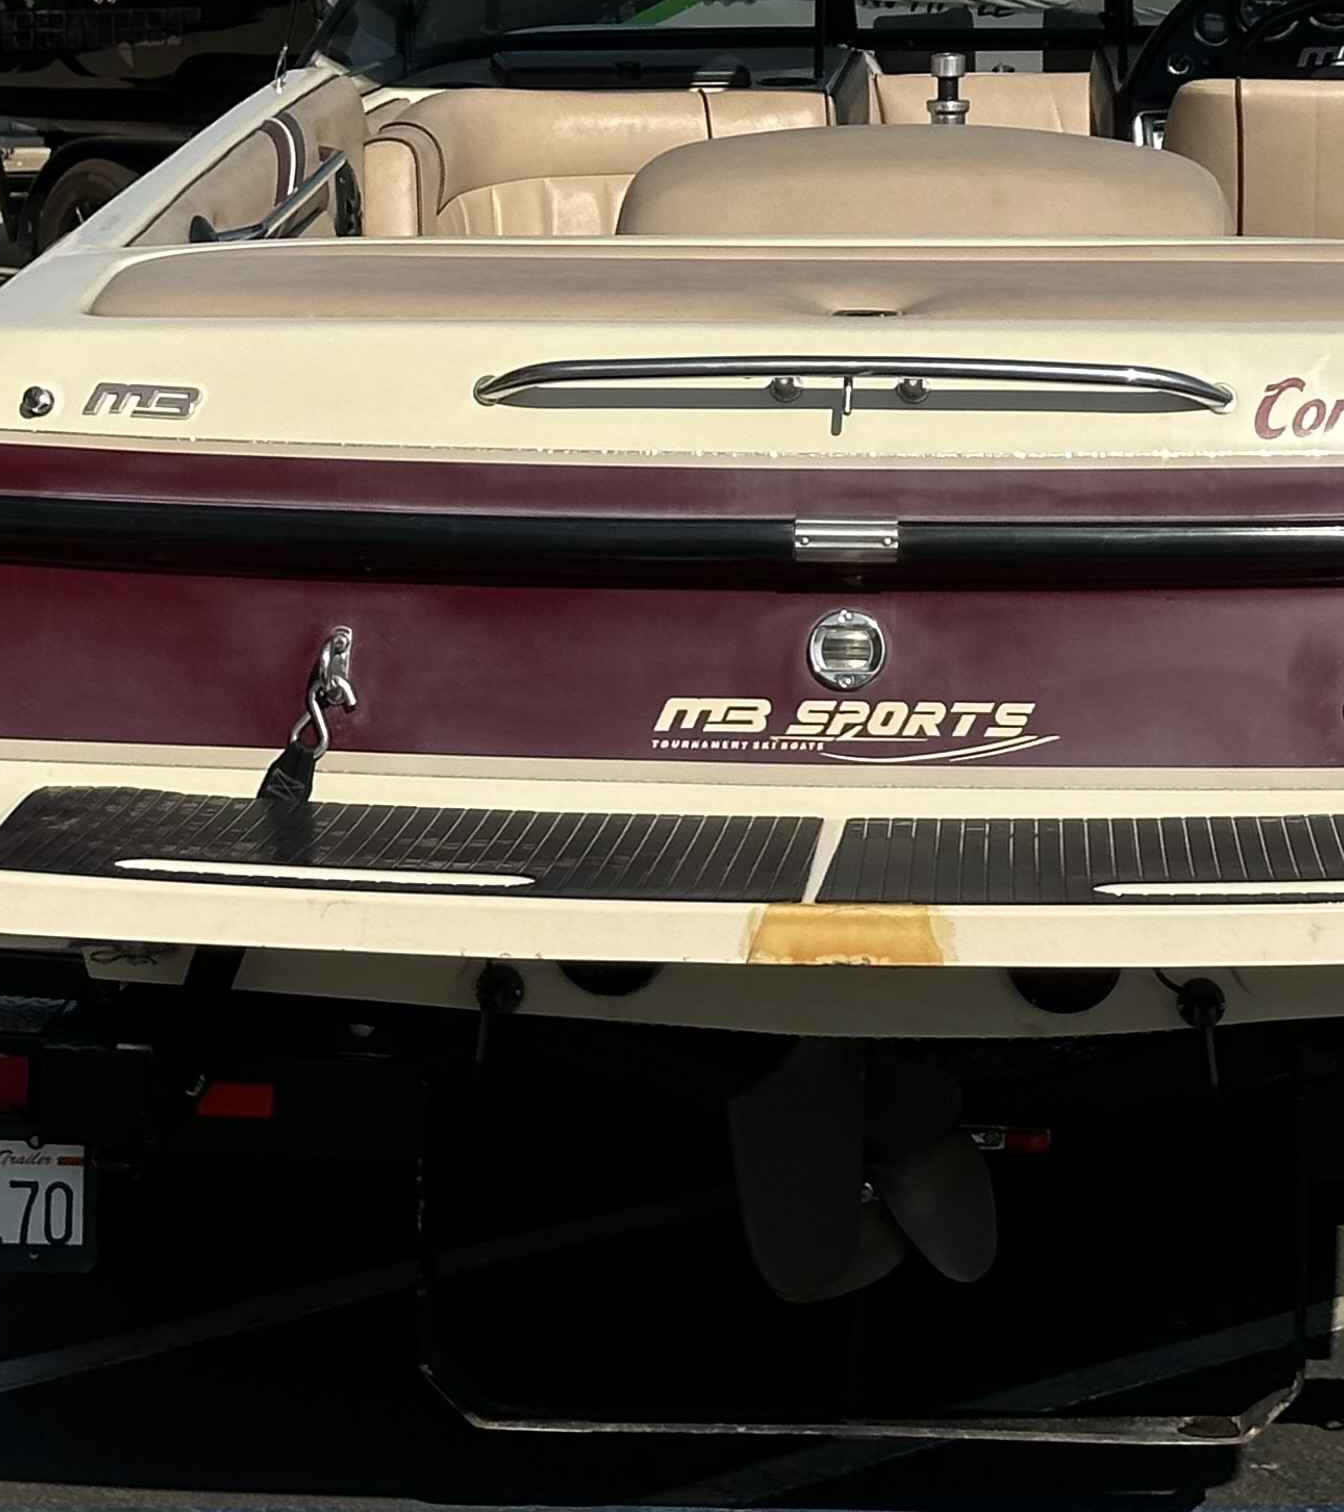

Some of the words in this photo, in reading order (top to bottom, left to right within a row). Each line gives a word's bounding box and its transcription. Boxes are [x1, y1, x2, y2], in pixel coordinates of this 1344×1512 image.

[82, 382, 204, 421] MB
[653, 696, 774, 734] MB
[784, 699, 1037, 738] SPORTS
[651, 738, 749, 750] TOURNAMENT
[752, 739, 777, 750] SKI
[780, 740, 825, 752] BOATS
